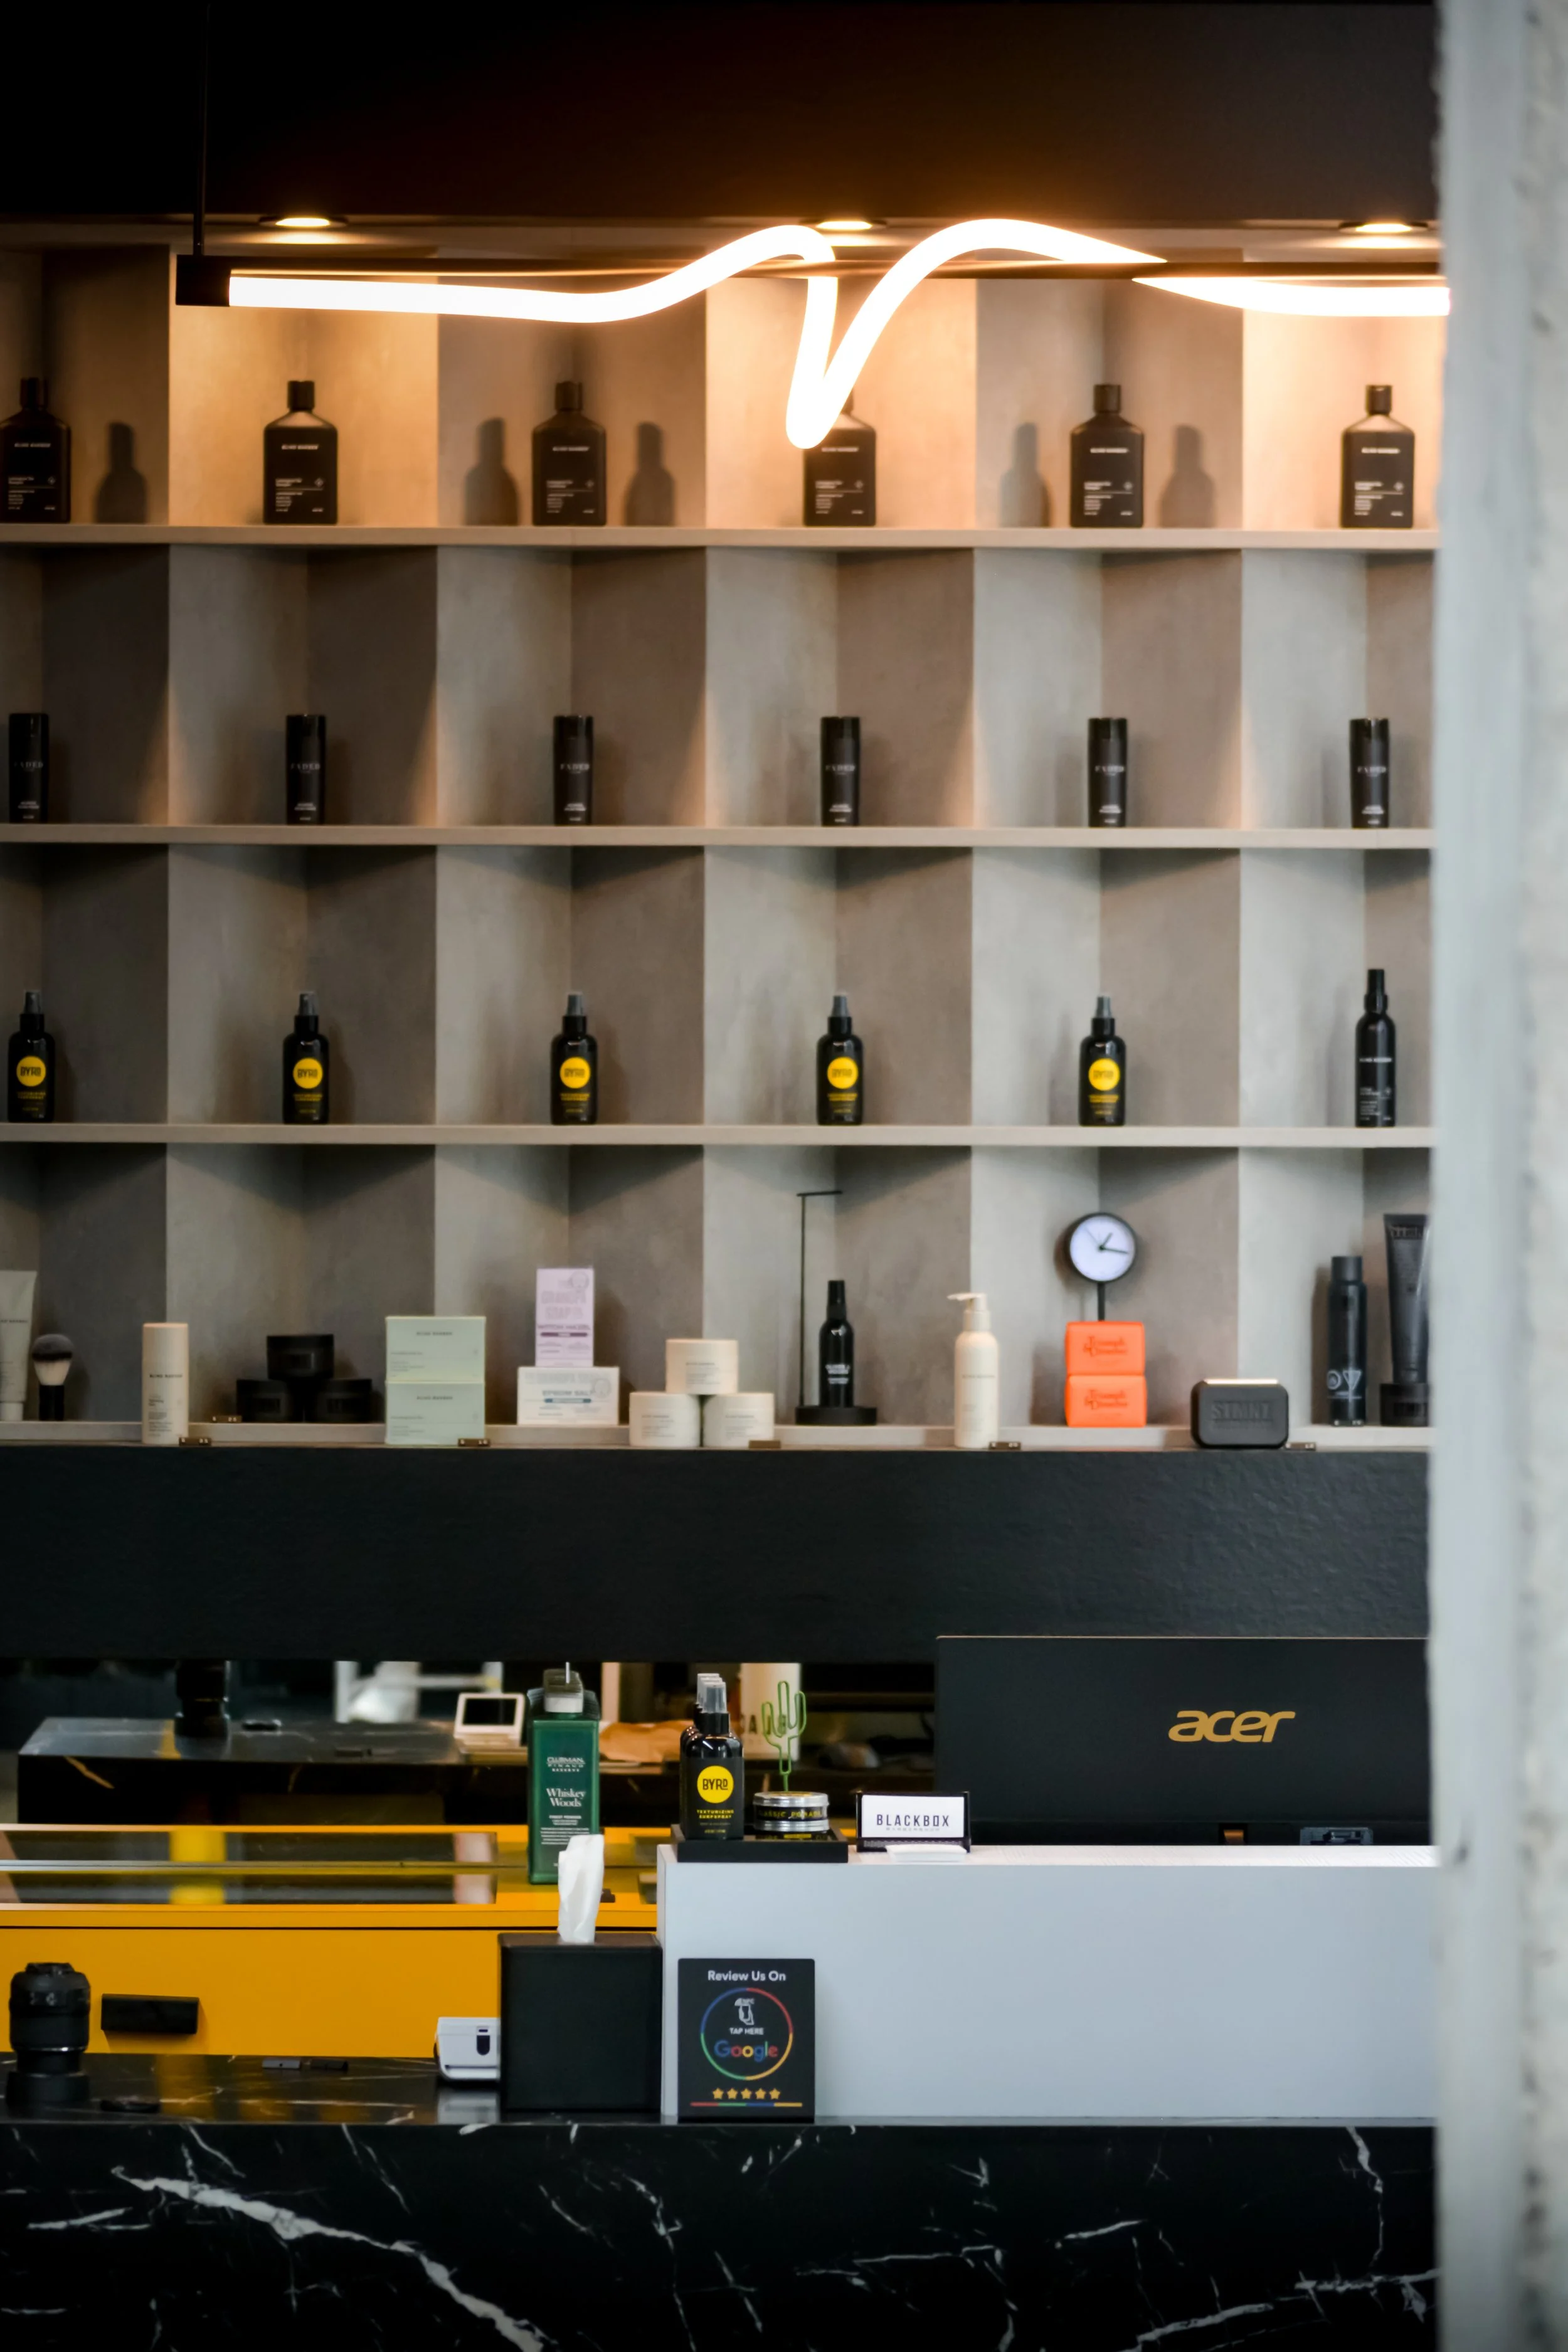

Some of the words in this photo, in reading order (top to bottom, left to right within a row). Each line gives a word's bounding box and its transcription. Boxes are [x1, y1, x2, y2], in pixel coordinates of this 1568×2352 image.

[1168, 1710, 1296, 1743] acer
[702, 1778, 728, 1791] BYRD
[546, 1788, 586, 1799] Whiskey
[550, 1798, 582, 1807] Woods
[876, 1814, 949, 1827] BLACKBOX
[707, 1970, 749, 1981] Review
[751, 1971, 766, 1981] Us
[768, 1971, 787, 1981] On
[714, 2040, 779, 2063] Google
